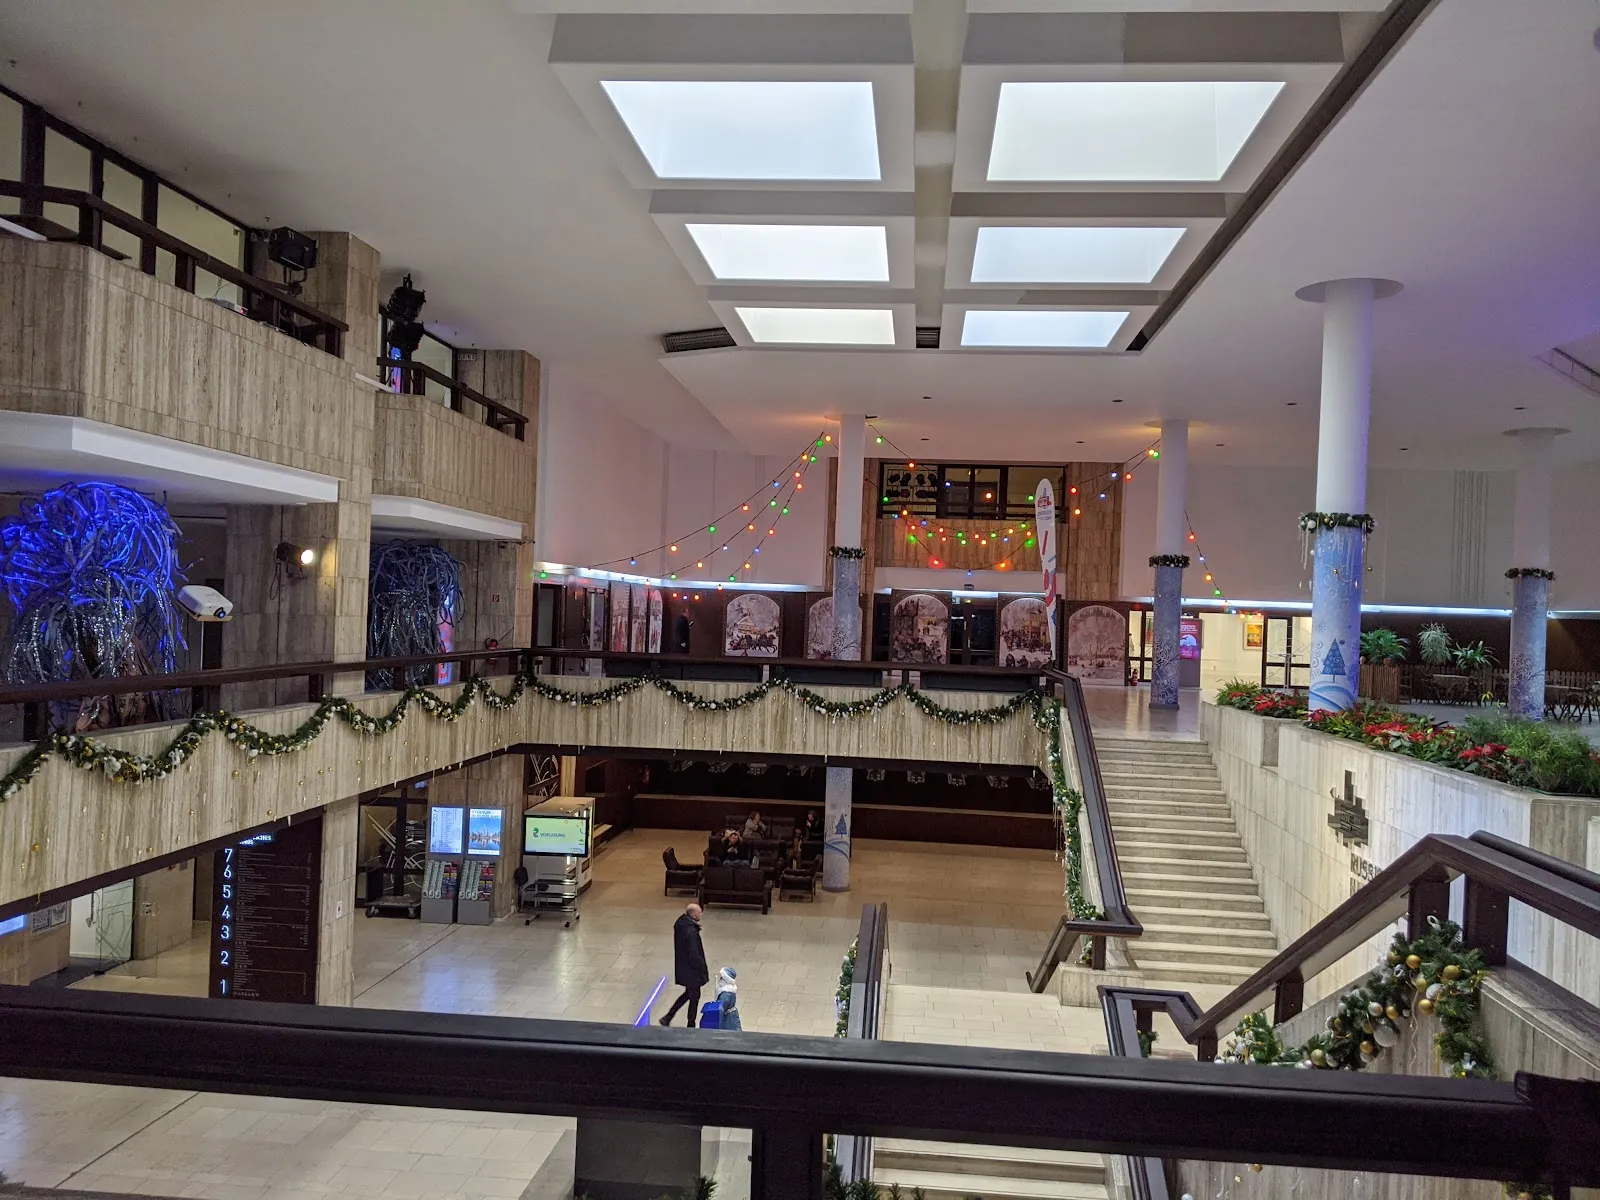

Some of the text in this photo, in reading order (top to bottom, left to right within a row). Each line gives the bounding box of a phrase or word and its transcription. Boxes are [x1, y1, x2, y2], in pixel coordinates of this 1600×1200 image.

[224, 848, 233, 862] 7
[223, 864, 232, 879] 6
[222, 884, 231, 899] 5
[221, 904, 231, 919] 4
[220, 925, 230, 939] 3
[220, 951, 229, 965] 2
[220, 979, 226, 994] 1
